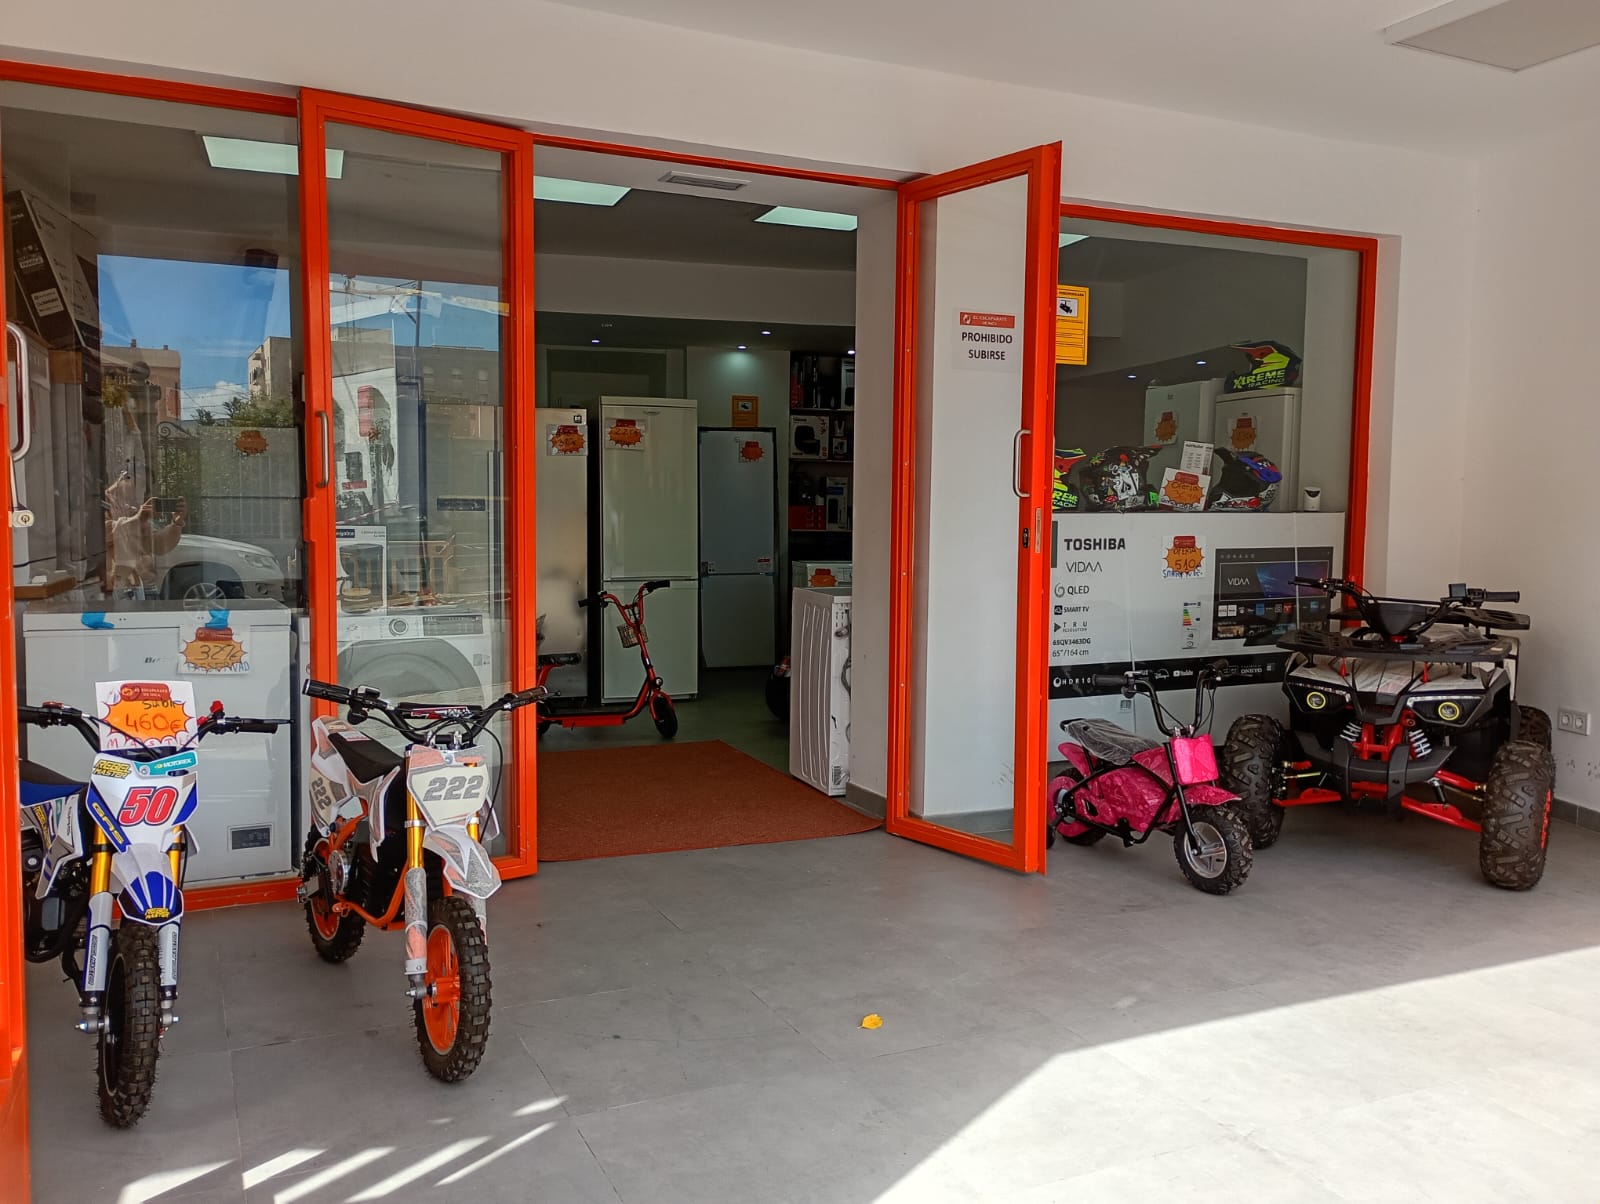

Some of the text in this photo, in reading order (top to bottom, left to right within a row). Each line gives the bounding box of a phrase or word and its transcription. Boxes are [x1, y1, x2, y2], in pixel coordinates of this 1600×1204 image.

[962, 332, 1013, 344] PROHIBIDO
[968, 350, 1005, 360] SUBIRSE
[1064, 538, 1126, 550] TOSHIBA
[1067, 585, 1090, 596] QLED
[126, 713, 181, 733] 460€
[97, 760, 130, 772] REBEL
[95, 769, 128, 778] MASTER
[311, 777, 332, 810] 222
[423, 775, 484, 801] 222
[117, 786, 178, 827] 50
